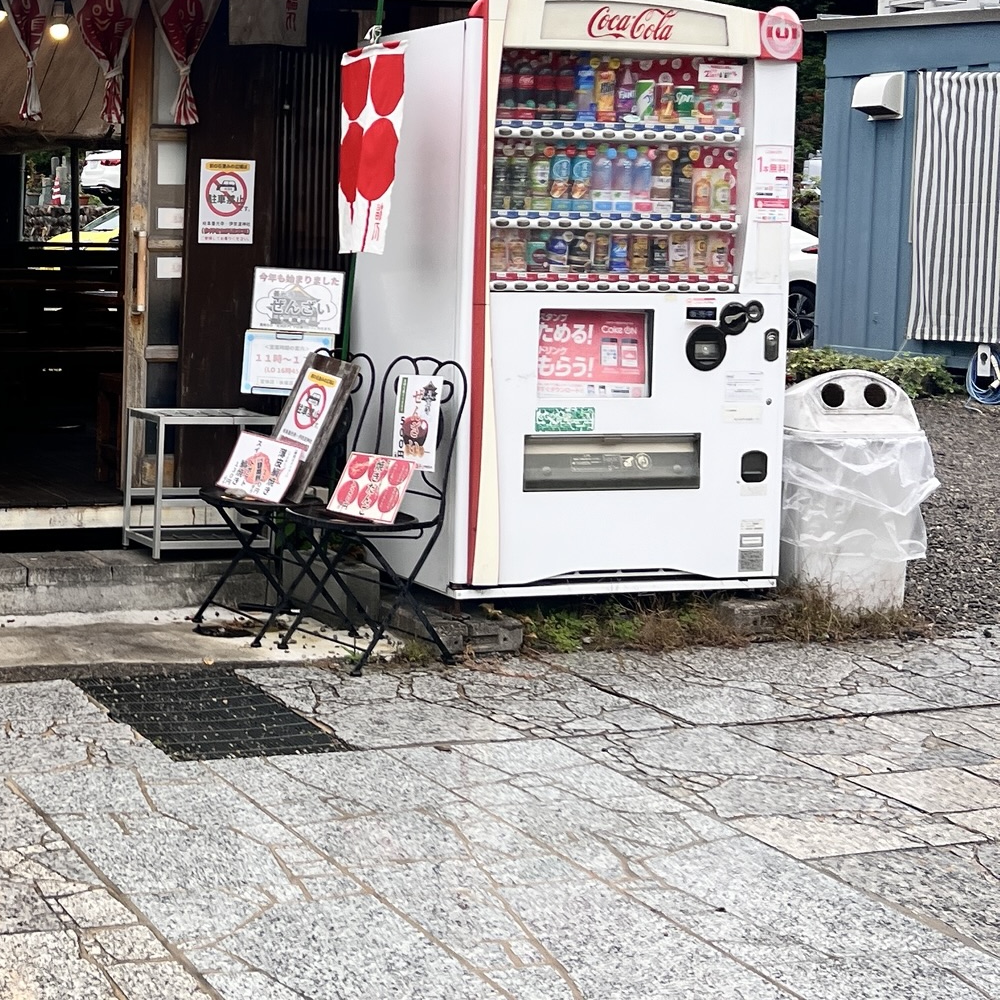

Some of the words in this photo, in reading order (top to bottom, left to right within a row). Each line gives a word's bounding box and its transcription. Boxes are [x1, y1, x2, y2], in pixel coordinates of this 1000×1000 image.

[587, 6, 679, 41] Coca-Cola
[208, 194, 245, 204] 駐車禁止
[259, 272, 340, 287] 今年も始まりました
[270, 298, 331, 316] ぜんざい
[601, 325, 623, 334] Coke
